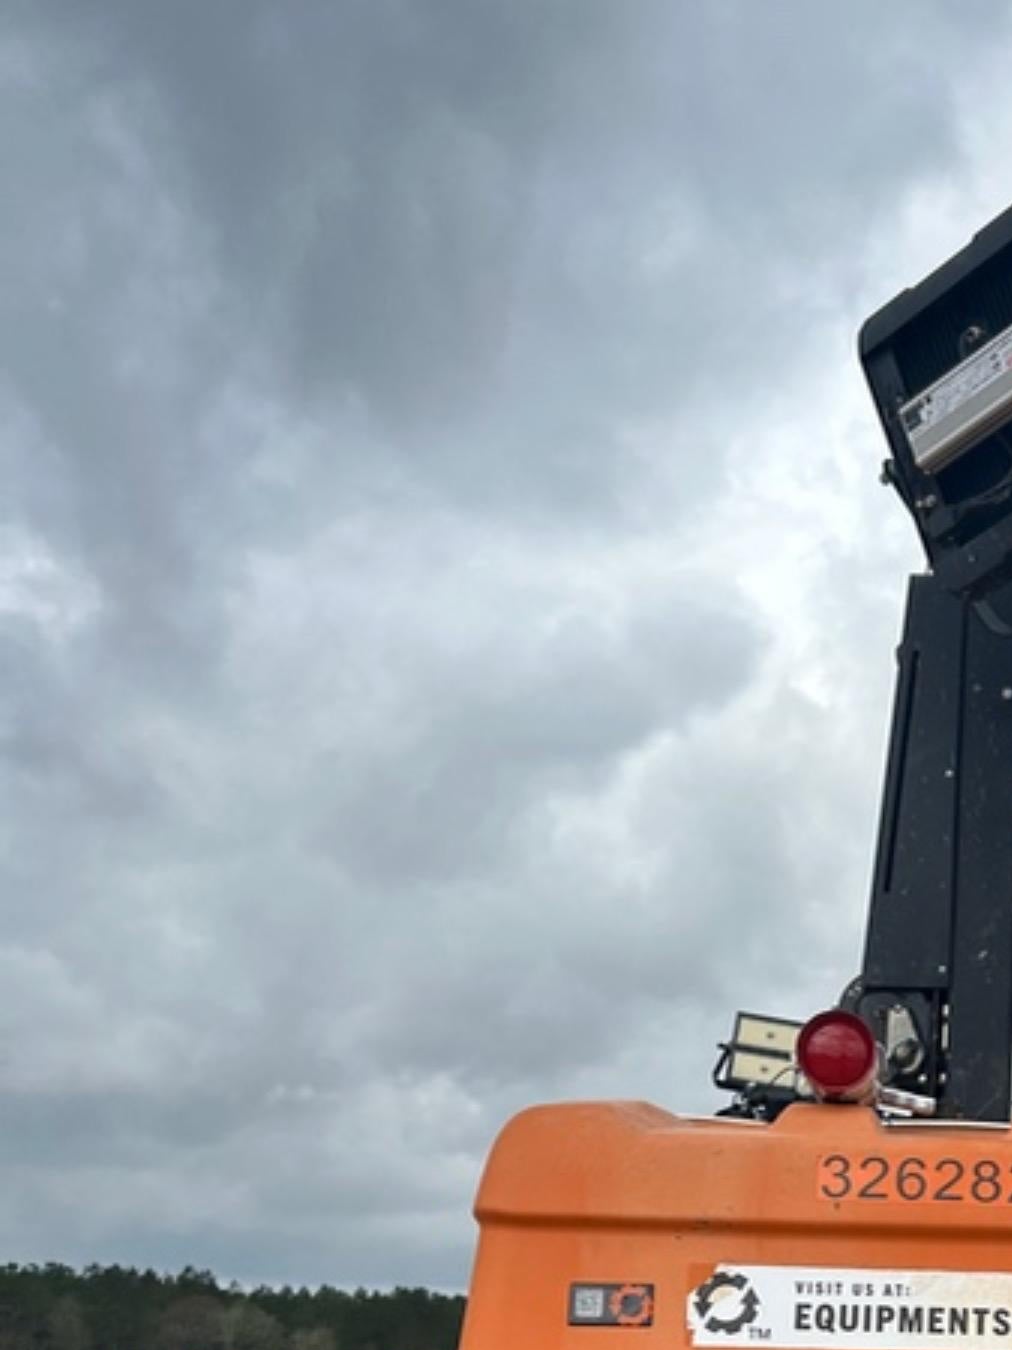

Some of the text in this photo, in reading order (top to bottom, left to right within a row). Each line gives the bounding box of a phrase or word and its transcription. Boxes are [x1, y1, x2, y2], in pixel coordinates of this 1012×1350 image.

[794, 1281, 911, 1298] VISIT US AT:
